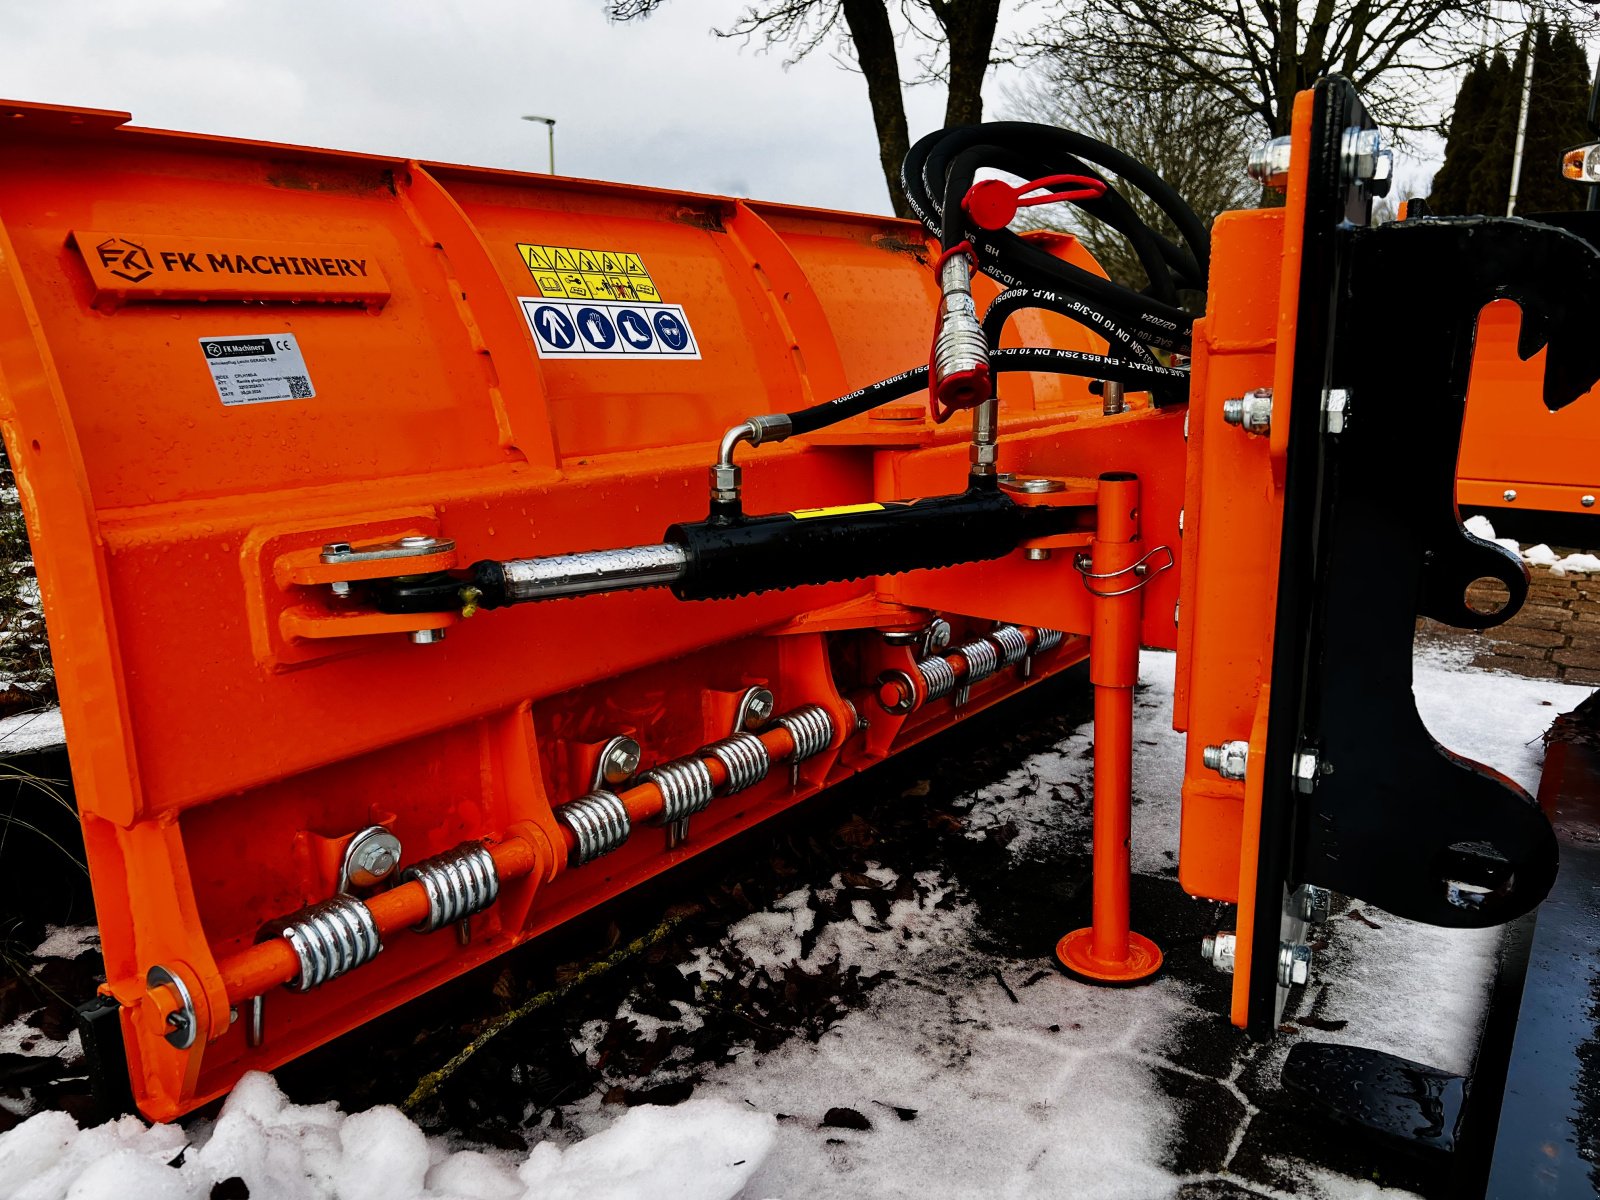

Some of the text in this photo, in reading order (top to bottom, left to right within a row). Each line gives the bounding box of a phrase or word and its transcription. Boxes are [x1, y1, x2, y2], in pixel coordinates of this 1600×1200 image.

[964, 230, 976, 244] SA
[984, 244, 1000, 257] HB
[159, 251, 203, 273] FK
[207, 253, 368, 277] MACHINERY
[995, 288, 1028, 304] 4800PSI
[1031, 288, 1056, 301] W.P.
[1066, 301, 1104, 324] ID-3/8"
[1104, 319, 1116, 331] 10
[1140, 313, 1176, 330] Q2/2024
[1116, 328, 1130, 342] DN
[232, 344, 265, 352] Machinery
[276, 340, 291, 350] CE
[1130, 340, 1144, 356] 2SN
[1154, 336, 1174, 348] SAE
[1033, 348, 1050, 356] DN
[1056, 350, 1078, 359] 2SN
[1082, 354, 1100, 362] 853
[1104, 356, 1119, 365] EN
[1128, 362, 1153, 372] R2AT
[1154, 366, 1168, 375] 100
[1169, 368, 1184, 378] SAE
